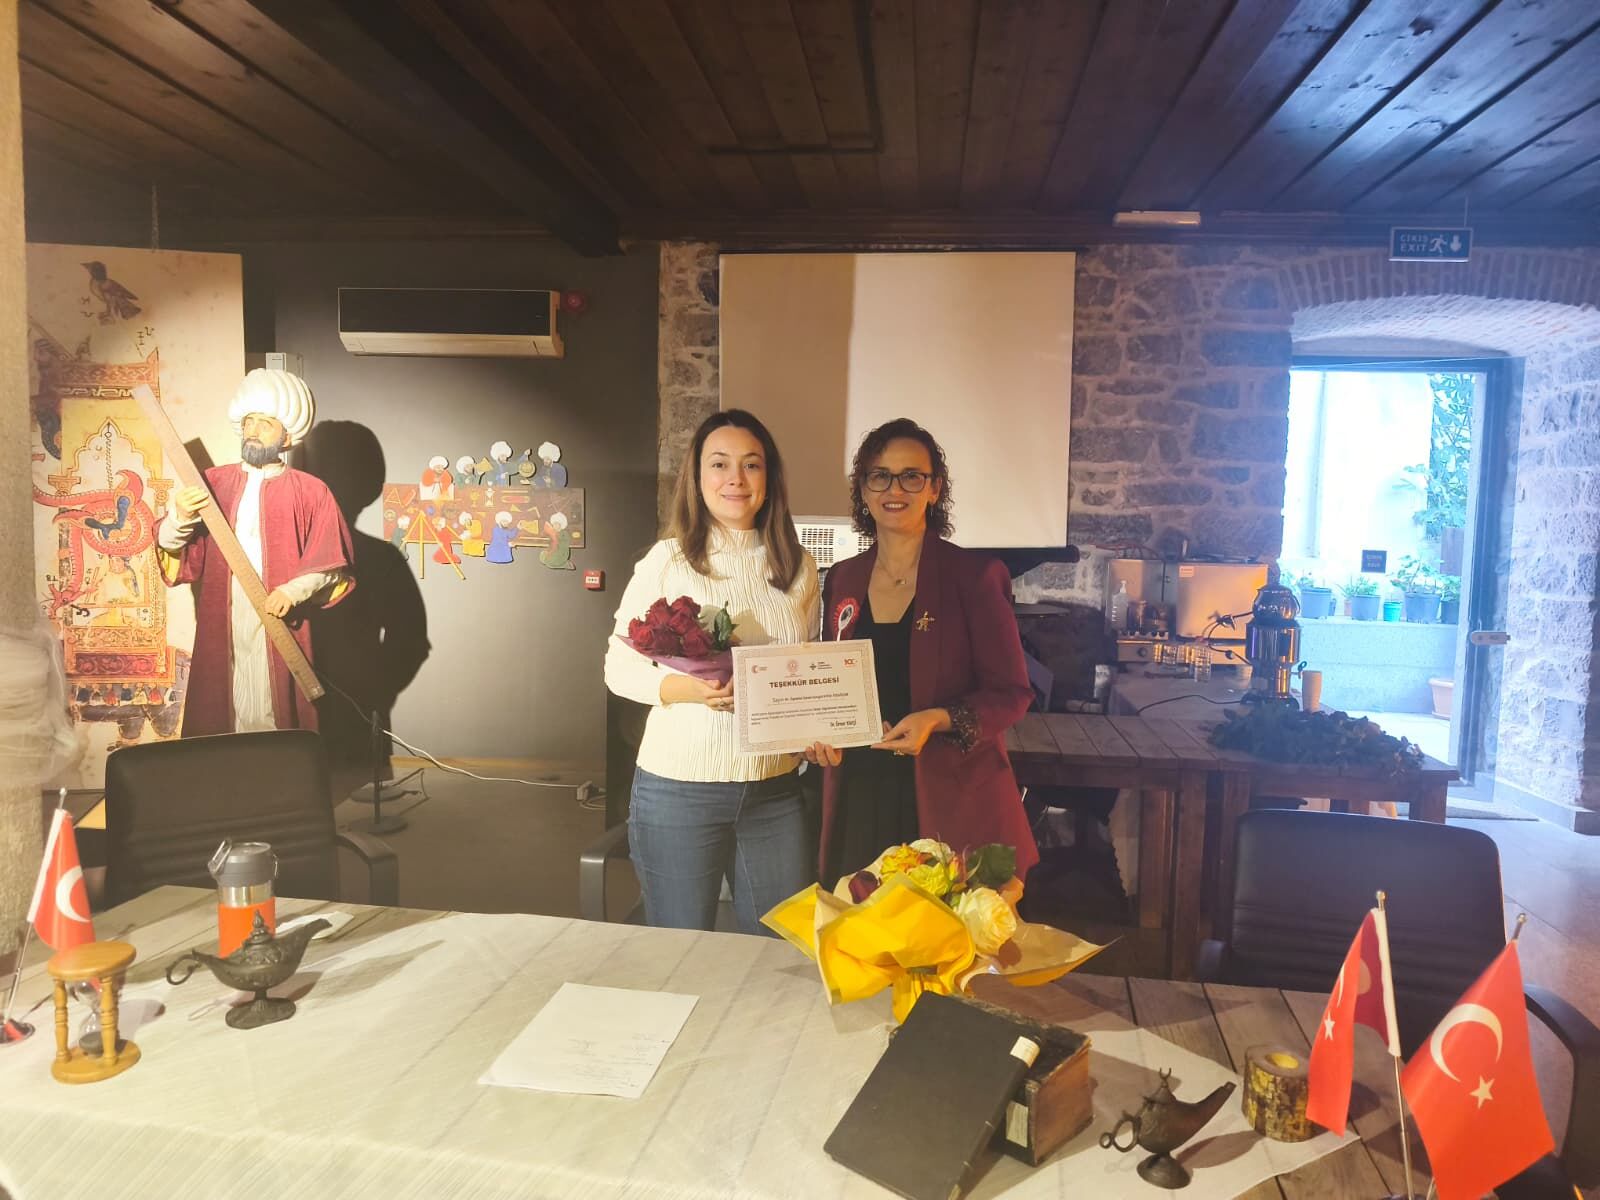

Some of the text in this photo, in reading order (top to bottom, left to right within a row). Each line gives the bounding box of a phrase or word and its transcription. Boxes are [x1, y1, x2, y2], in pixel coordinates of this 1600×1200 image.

[1400, 243, 1426, 252] EXIT
[768, 678, 807, 688] TEŞEKKÜR
[808, 676, 839, 685] BELGESİ
